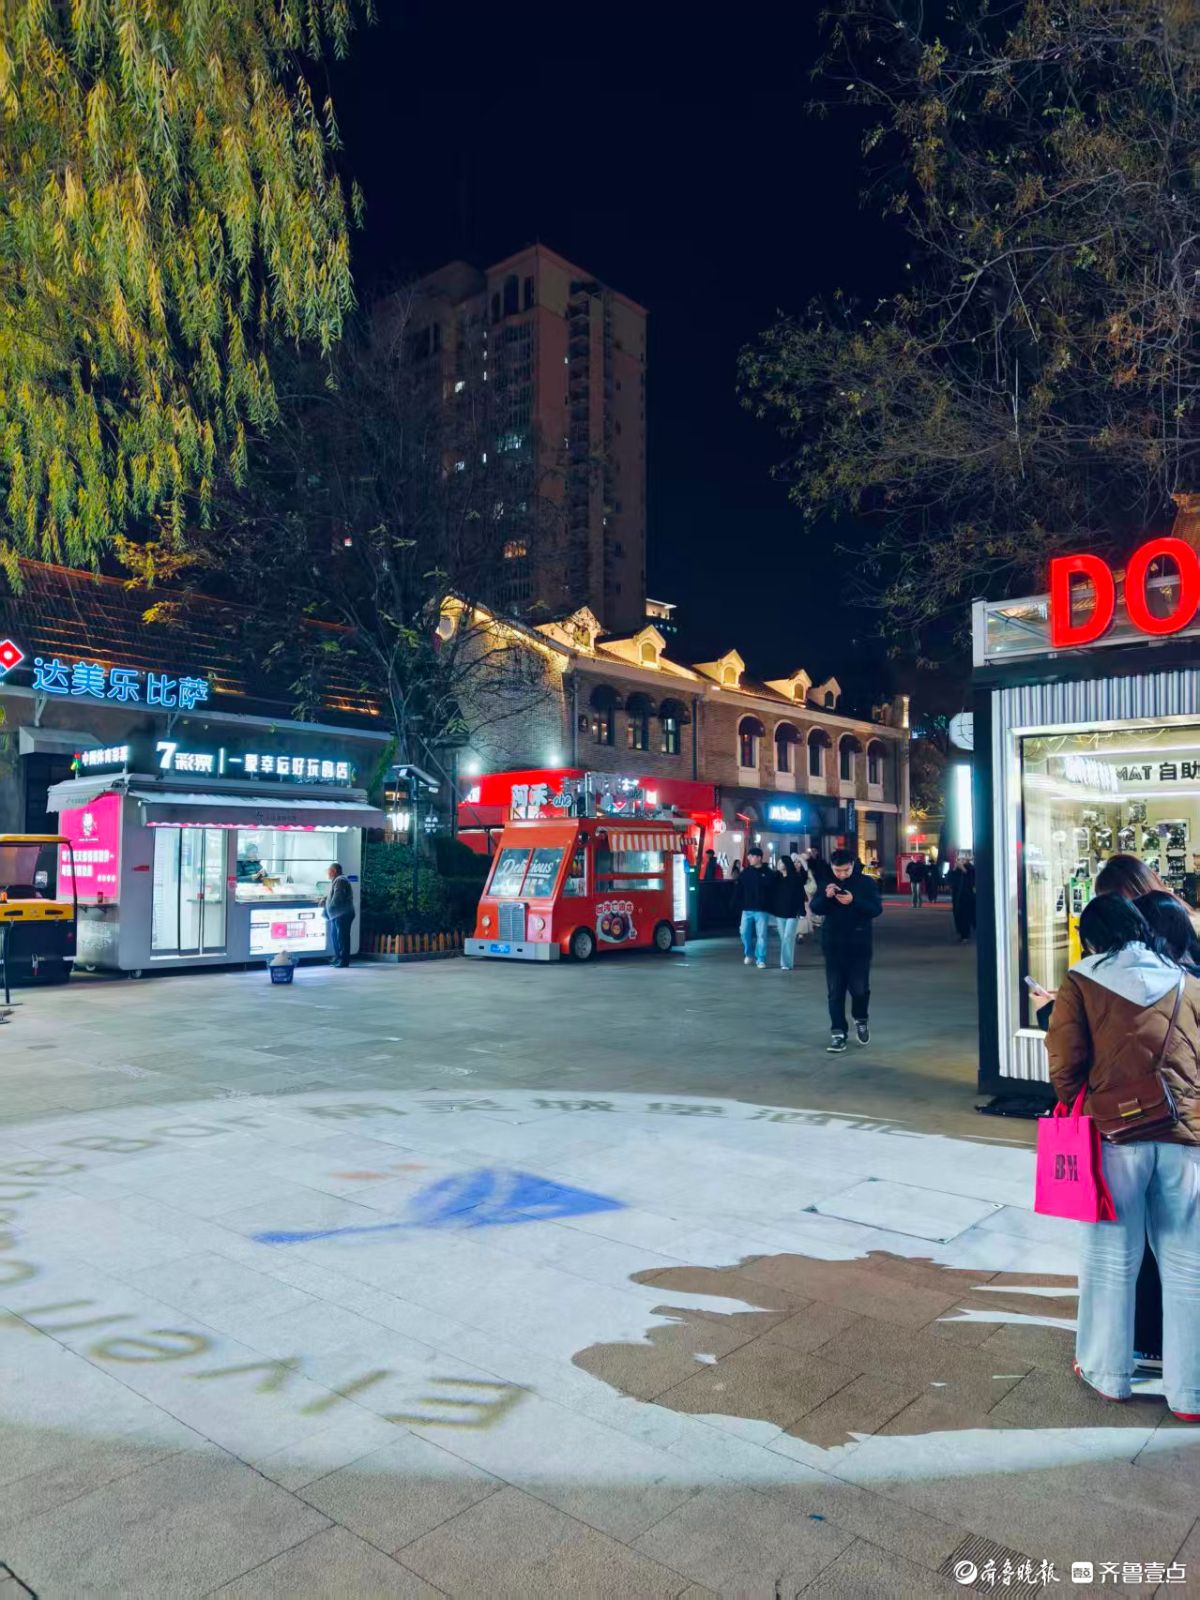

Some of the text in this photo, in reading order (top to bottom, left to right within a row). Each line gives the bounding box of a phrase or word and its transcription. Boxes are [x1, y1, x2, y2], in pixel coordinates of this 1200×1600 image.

[32, 657, 209, 710] 达美乐比萨
